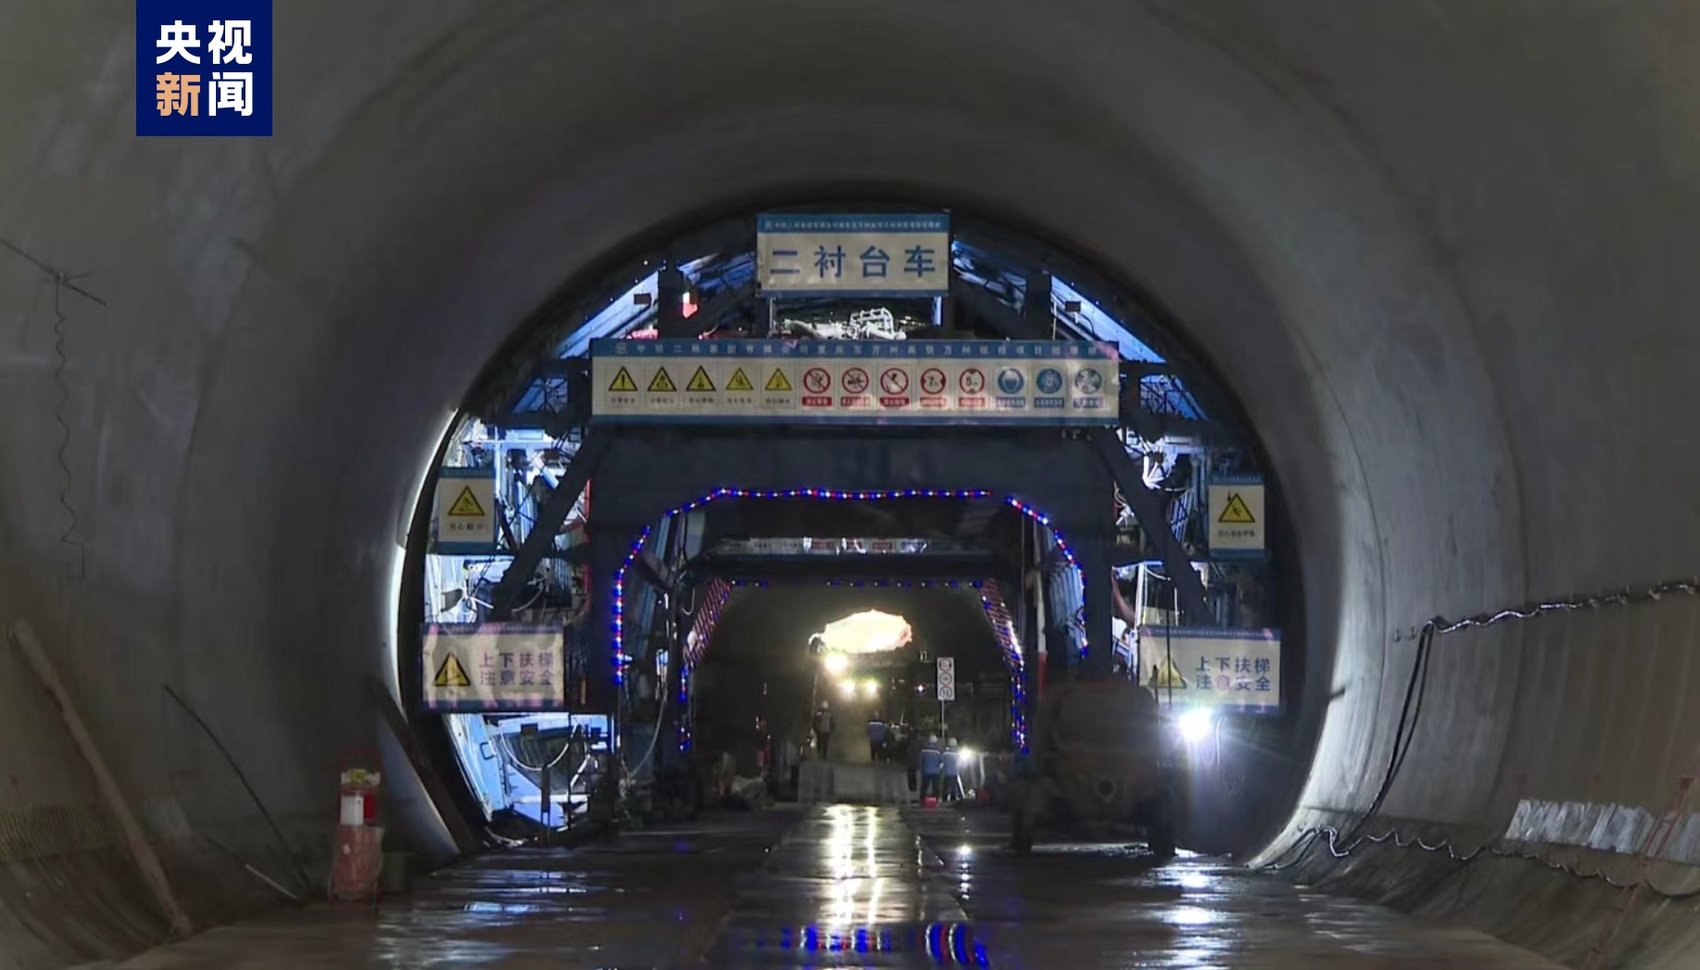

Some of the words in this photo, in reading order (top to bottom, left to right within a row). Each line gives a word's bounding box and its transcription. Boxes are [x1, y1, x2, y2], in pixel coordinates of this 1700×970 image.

[770, 244, 936, 279] 二衬台车
[479, 651, 554, 669] 上下扶梯
[1195, 656, 1271, 674] 上下扶梯
[479, 669, 554, 687] 注意安全
[1195, 674, 1271, 692] 注意安全
